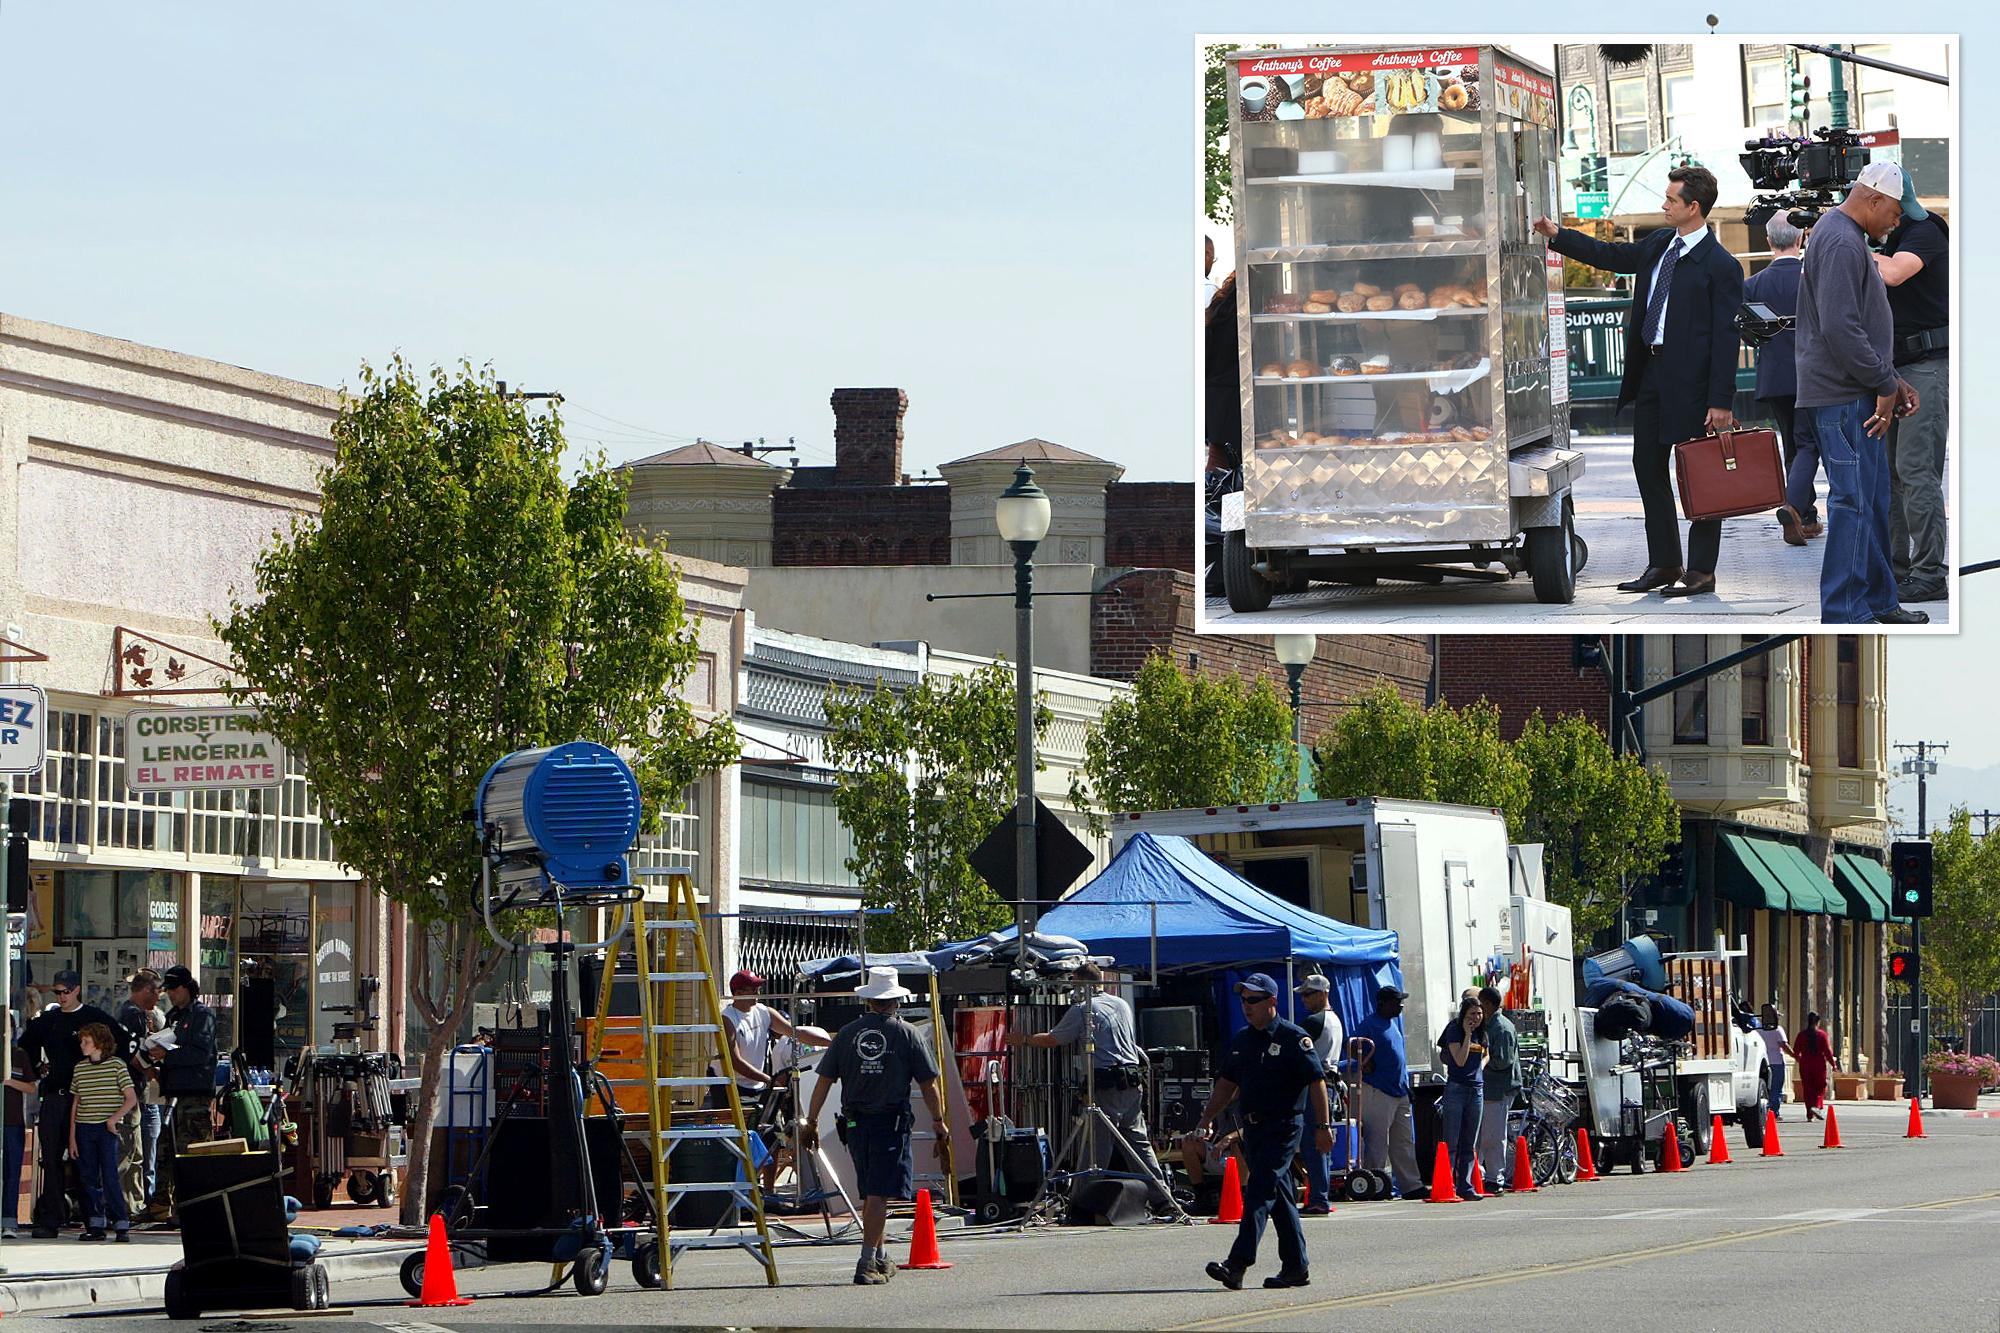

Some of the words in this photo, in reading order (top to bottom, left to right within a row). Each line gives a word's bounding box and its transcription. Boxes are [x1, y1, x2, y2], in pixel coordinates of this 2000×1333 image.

[1252, 59, 1303, 72] Anthony's
[1309, 56, 1342, 71] Coffee
[1372, 53, 1424, 66] Anthony's
[1430, 50, 1462, 64] Coffee
[1565, 311, 1624, 327] Subway
[194, 732, 216, 743] Y
[143, 743, 268, 762] LENCERIA
[137, 767, 166, 783] EL
[174, 763, 275, 782] REMATE
[150, 901, 178, 919] GODESS
[148, 951, 176, 968] ARDYSS
